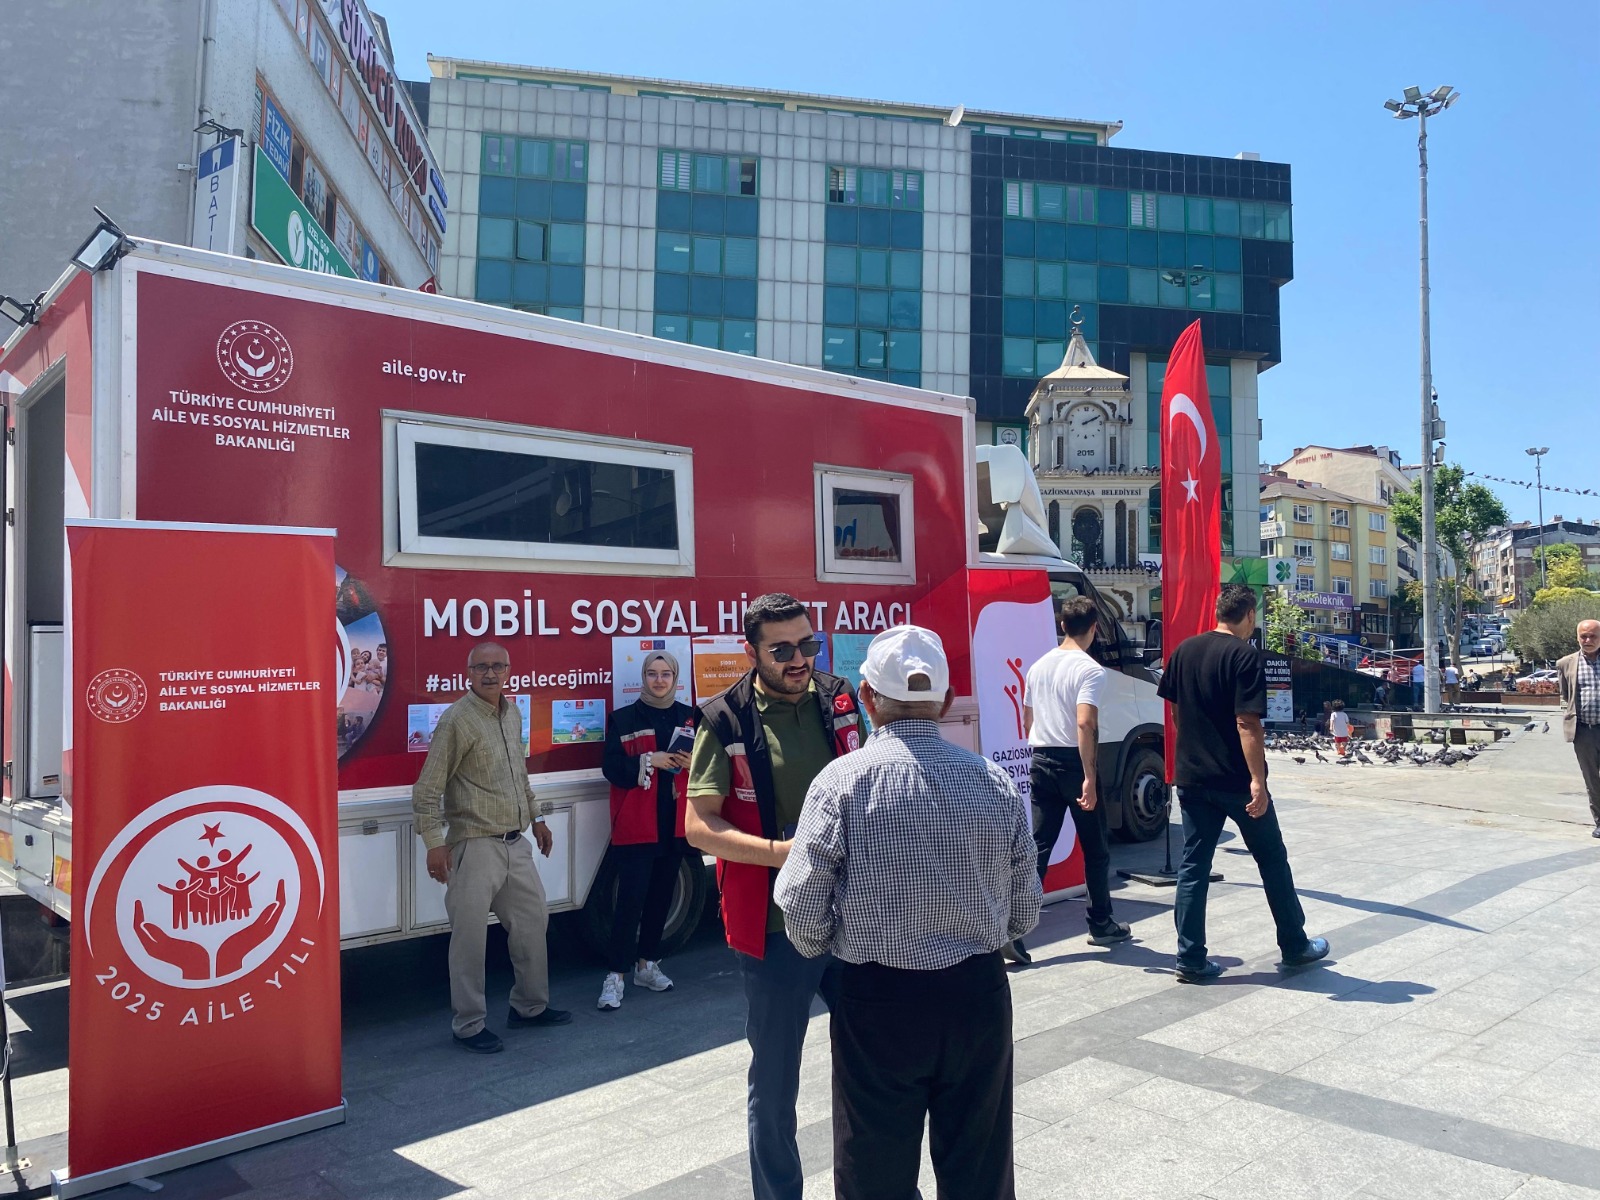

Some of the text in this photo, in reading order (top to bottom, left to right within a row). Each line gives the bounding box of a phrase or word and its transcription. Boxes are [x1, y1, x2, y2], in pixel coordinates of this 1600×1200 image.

[340, 0, 395, 128] SÜRÜCÜ
[266, 107, 290, 157] FİZİK
[265, 133, 290, 177] TEDAVİ
[208, 174, 220, 252] BATI
[308, 220, 320, 245] ÖZEL
[381, 358, 467, 384] aile.gov.tr
[169, 390, 335, 421] TÜRKİYE CUMHURİYETİ
[152, 407, 350, 440] AİLE VE SOSYAL HİZMETLER
[215, 433, 295, 453] BAKANLIĞI
[1040, 488, 1142, 498] GAZİOSMANPAŞA BELEDİYESİ
[423, 588, 912, 638] MOBİL SOSYAL HİT ARACI
[159, 667, 296, 682] TÜRKİYE CUMHURİYETİ
[1266, 659, 1288, 667] DAKİK
[159, 681, 321, 697] AİLE VE SOSYAL HİZMETLER
[425, 667, 612, 693] #ailezgeleceğimiz
[159, 697, 226, 711] BAKANLIĞI
[992, 746, 1033, 763] GAZİOSM
[1003, 763, 1031, 779] SYAL
[95, 937, 315, 1025] 2025 AİLE YILI
